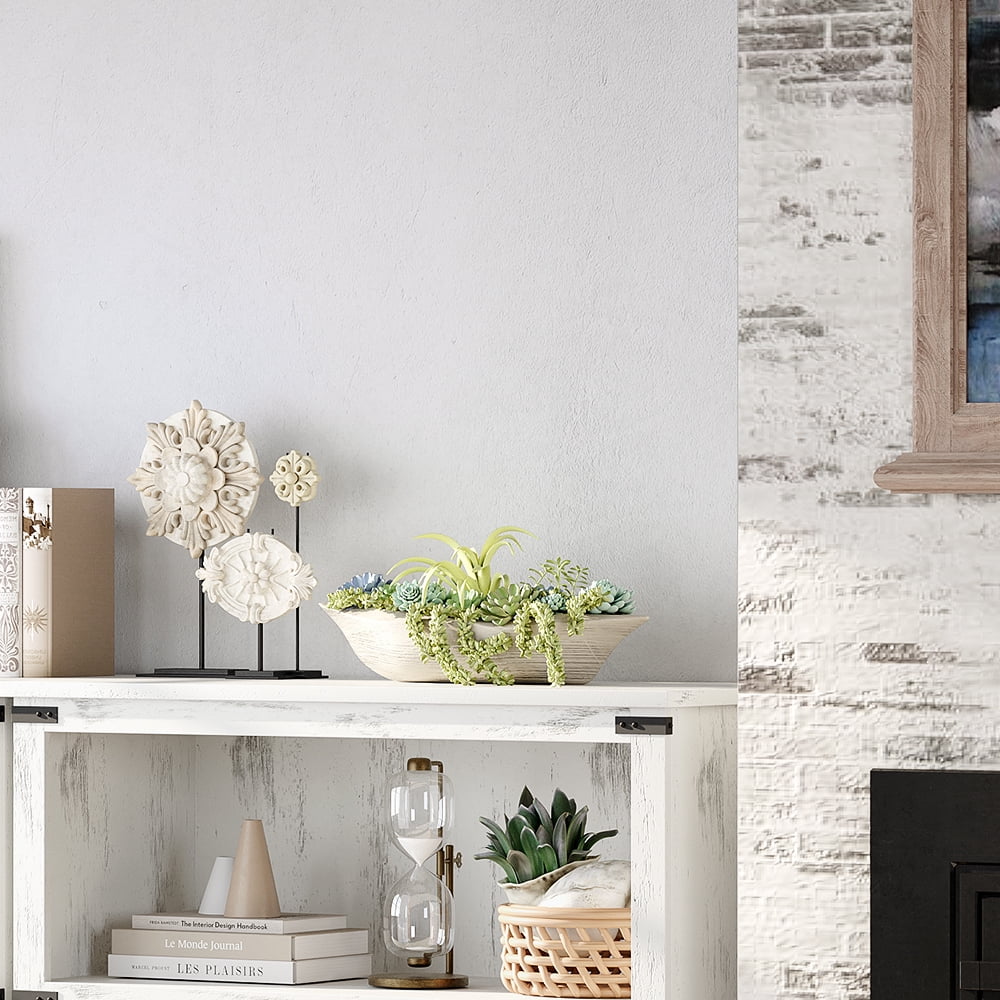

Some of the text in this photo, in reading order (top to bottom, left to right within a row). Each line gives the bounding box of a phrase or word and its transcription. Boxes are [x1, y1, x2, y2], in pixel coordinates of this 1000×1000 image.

[181, 920, 192, 928] The
[215, 922, 236, 930] Design
[237, 922, 268, 930] Handbook
[165, 939, 243, 951] Le Monde Journal
[178, 963, 200, 974] LES
[205, 964, 264, 977] PLAISIRS
